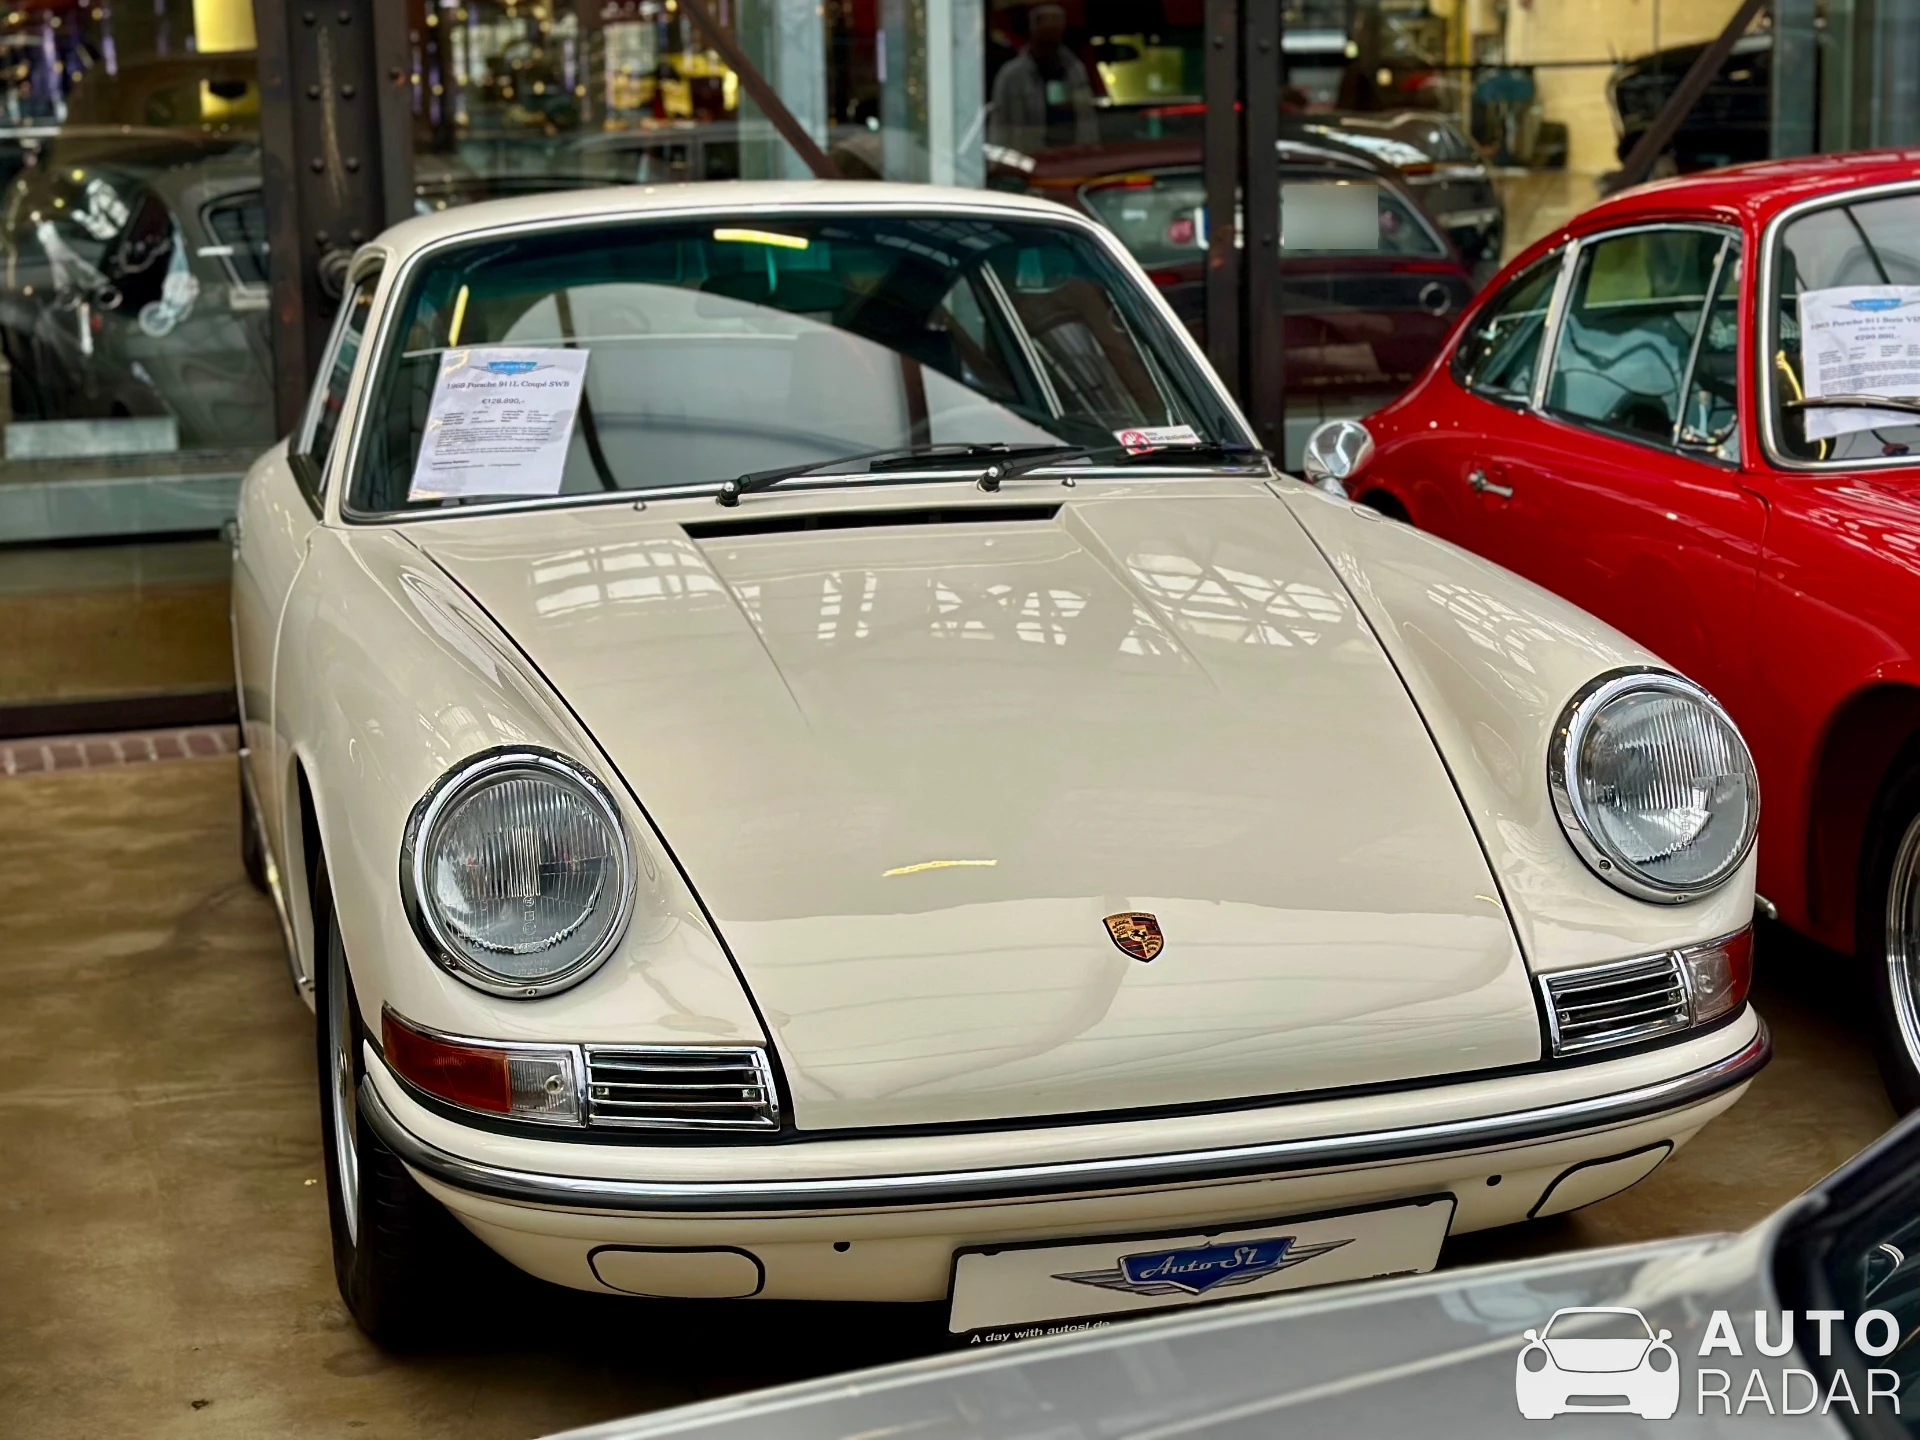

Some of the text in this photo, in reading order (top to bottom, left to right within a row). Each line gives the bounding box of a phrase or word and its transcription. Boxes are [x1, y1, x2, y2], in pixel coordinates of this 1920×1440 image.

[1832, 319, 1864, 327] Porsche
[447, 380, 570, 390] 1968 Porsche 911L Coupé SWB
[970, 1320, 1111, 1344] A day with autosl.de
